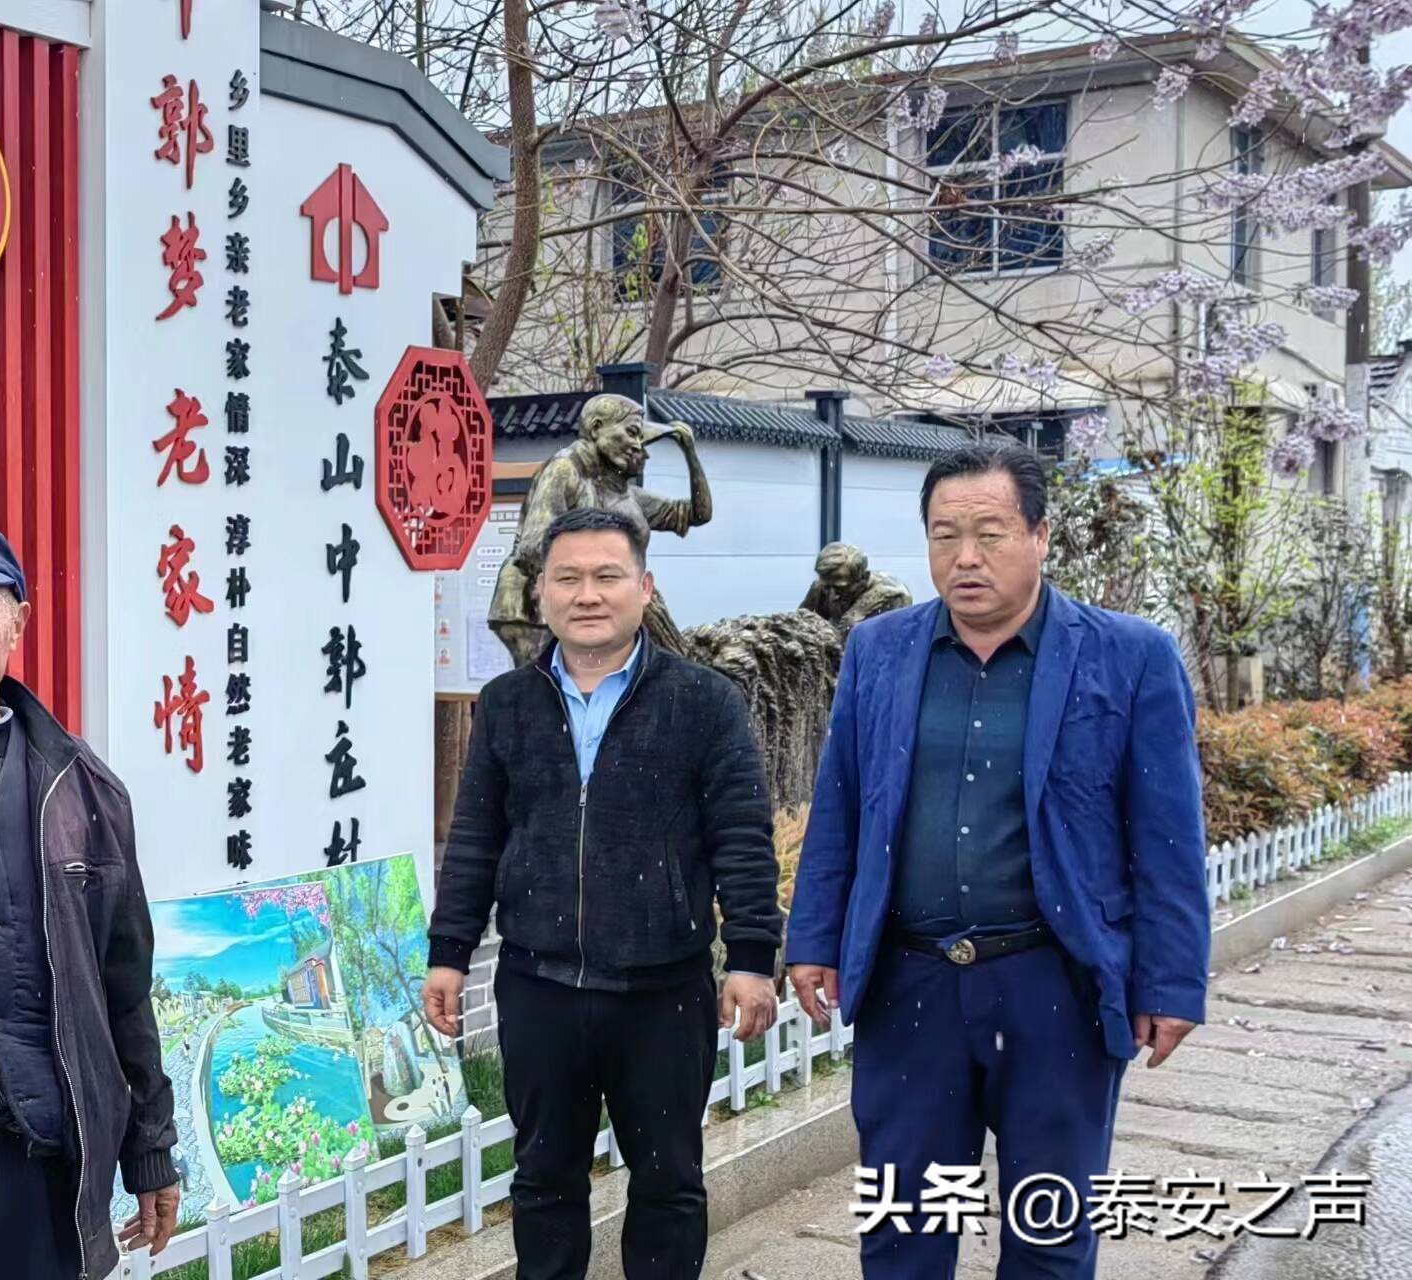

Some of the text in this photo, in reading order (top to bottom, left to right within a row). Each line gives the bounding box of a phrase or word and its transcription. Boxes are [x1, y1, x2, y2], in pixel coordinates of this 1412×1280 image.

[150, 0, 215, 774] 郭梦 老家情
[224, 69, 254, 887] 乡里乡亲老家情深 淳朴自然老家味
[320, 317, 371, 868] 泰山中郭庄村
